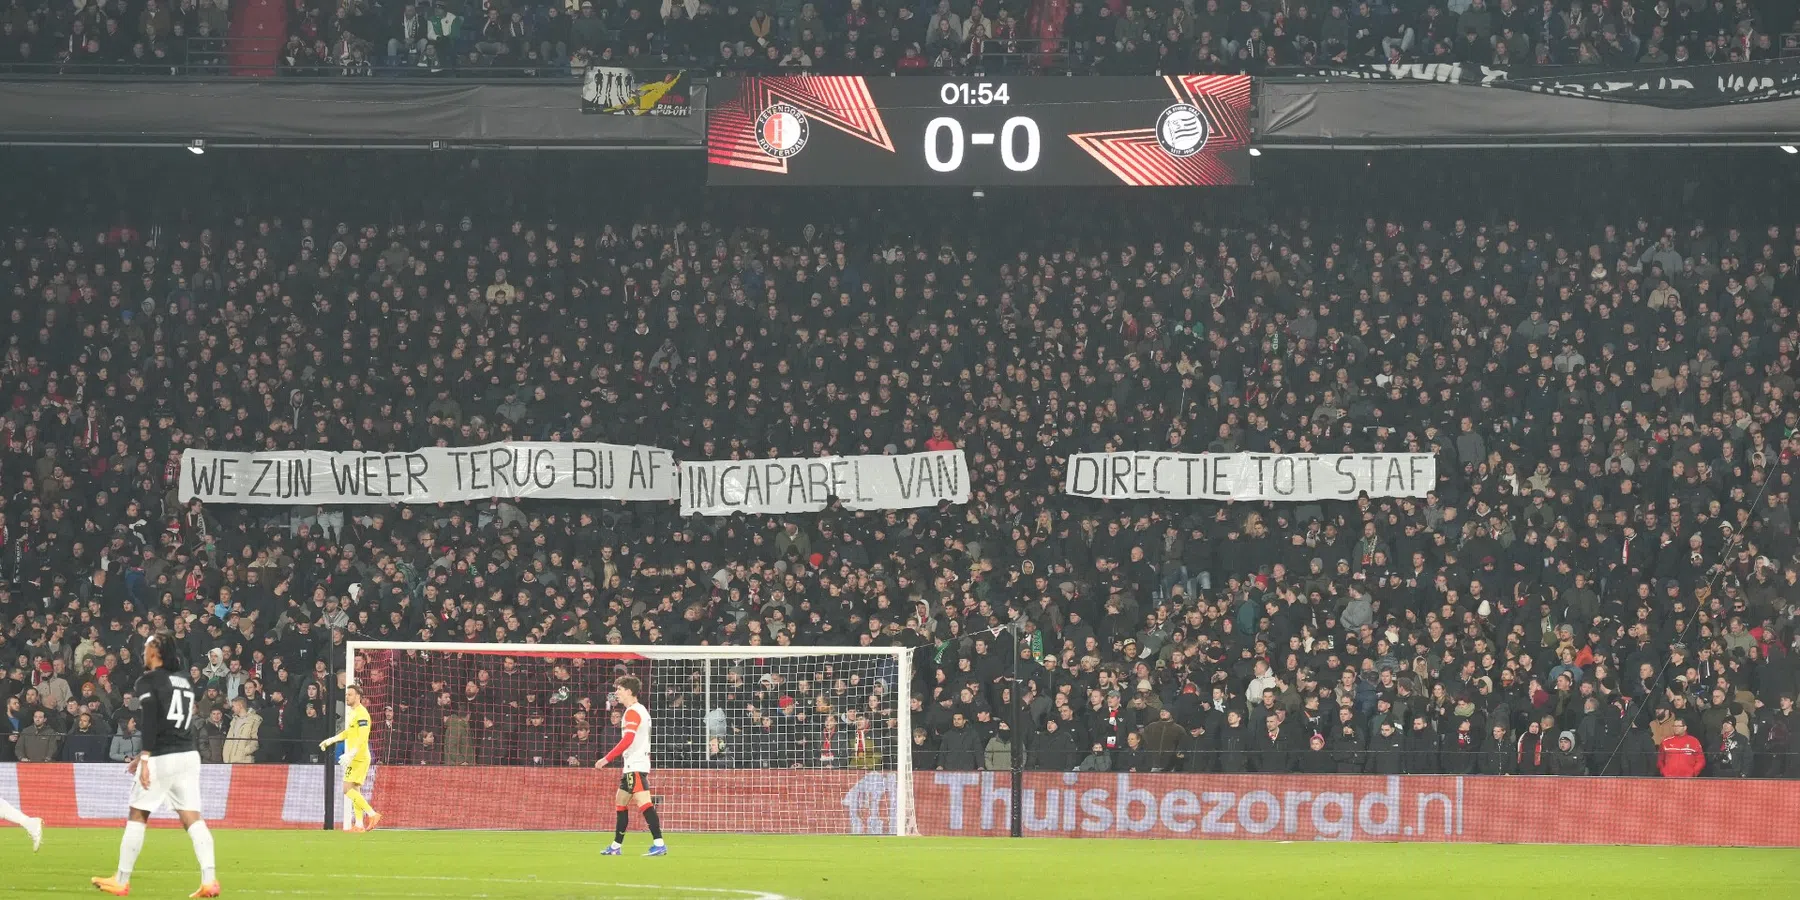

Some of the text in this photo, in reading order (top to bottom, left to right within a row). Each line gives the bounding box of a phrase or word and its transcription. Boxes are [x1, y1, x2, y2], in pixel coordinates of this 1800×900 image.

[760, 106, 805, 124] FEYENOORD
[941, 83, 1010, 105] 01:54
[760, 138, 805, 157] ROTTERDAM
[924, 116, 1041, 172] 0-0
[190, 456, 239, 497] WE
[249, 458, 312, 499] ZIJN
[330, 453, 429, 497] WEER
[447, 448, 556, 491] TERUG
[572, 448, 614, 490] BIJ
[688, 454, 959, 509] INCAPABEL VAN
[1072, 455, 1429, 496] DIRECTIE TOT STAF
[166, 688, 195, 731] 47
[934, 771, 1464, 842] Thuisbezorgd.nl
